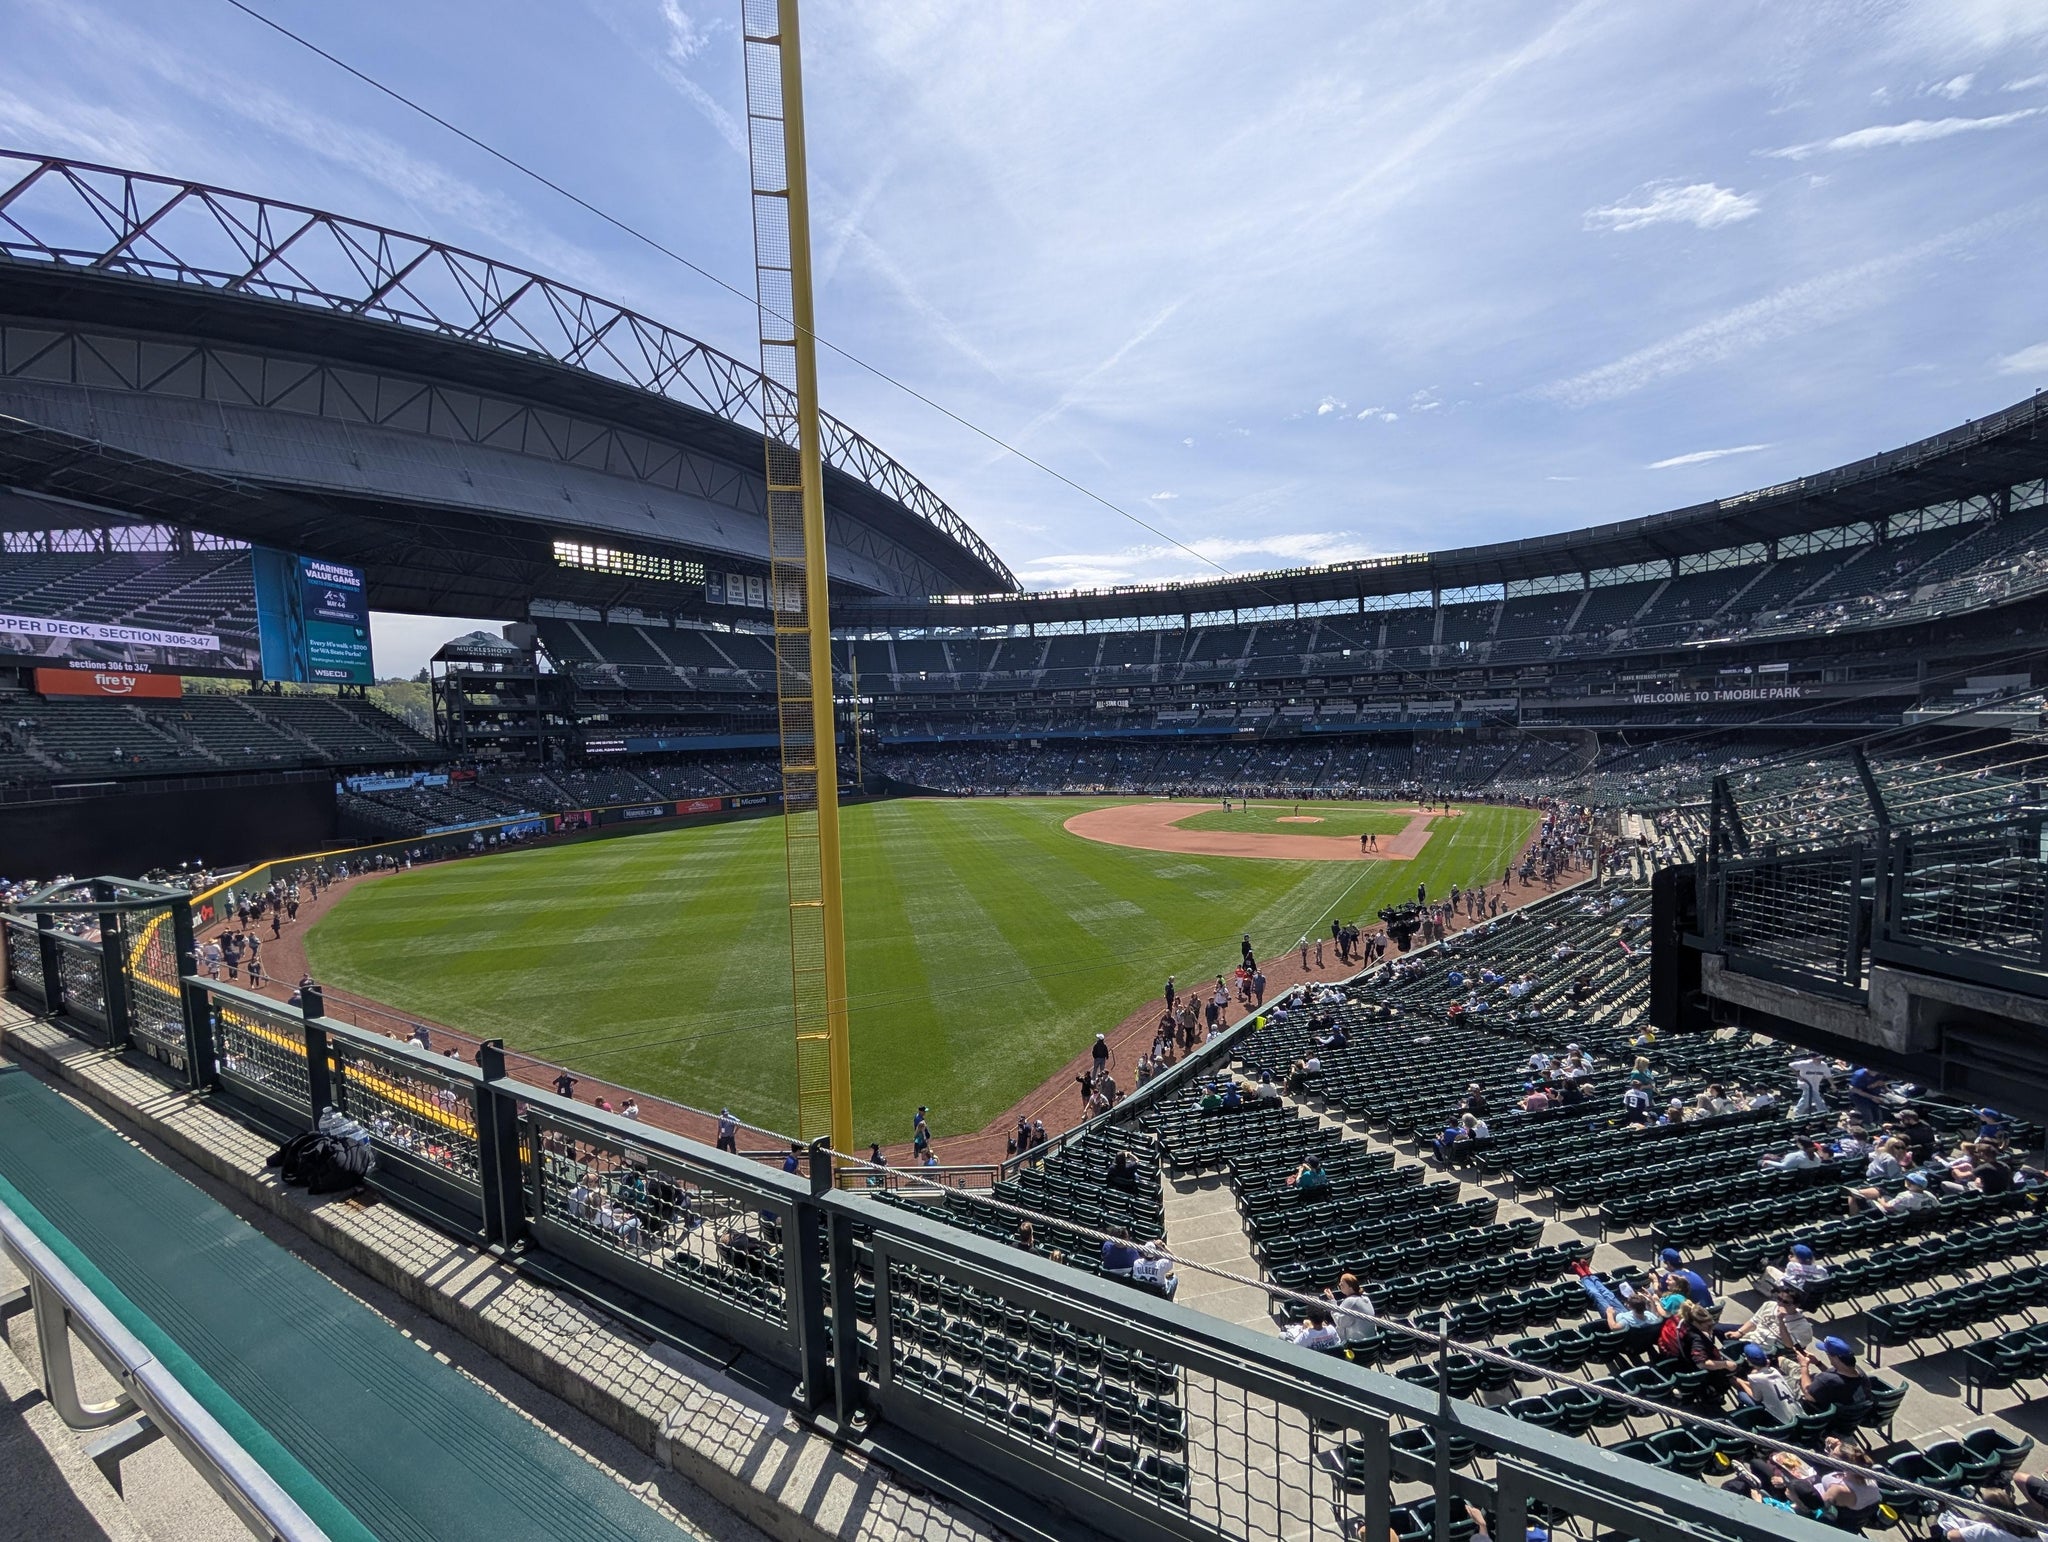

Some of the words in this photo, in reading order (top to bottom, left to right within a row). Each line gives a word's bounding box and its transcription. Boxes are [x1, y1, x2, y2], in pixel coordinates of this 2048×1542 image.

[312, 562, 354, 577] MARINERS
[305, 569, 332, 582] VALUE
[332, 574, 360, 586] GAMES
[46, 622, 94, 638] DECK,
[100, 628, 162, 643] SECTION
[165, 634, 210, 646] 306-347
[310, 640, 326, 648] Every
[69, 660, 107, 669] sections
[108, 662, 123, 670] 306
[124, 663, 133, 671] to
[315, 669, 347, 678] WSECU
[94, 674, 120, 685] fire
[121, 676, 136, 686] tv
[1633, 692, 1690, 704] WELCOME
[1694, 692, 1709, 701] TO
[1714, 689, 1767, 700] T-MOBILE
[1770, 687, 1801, 698] PARK
[742, 796, 766, 805] Microsoft
[169, 1053, 183, 1070] 180
[1629, 1097, 1637, 1108] 9
[1136, 1266, 1158, 1276] GILBERT
